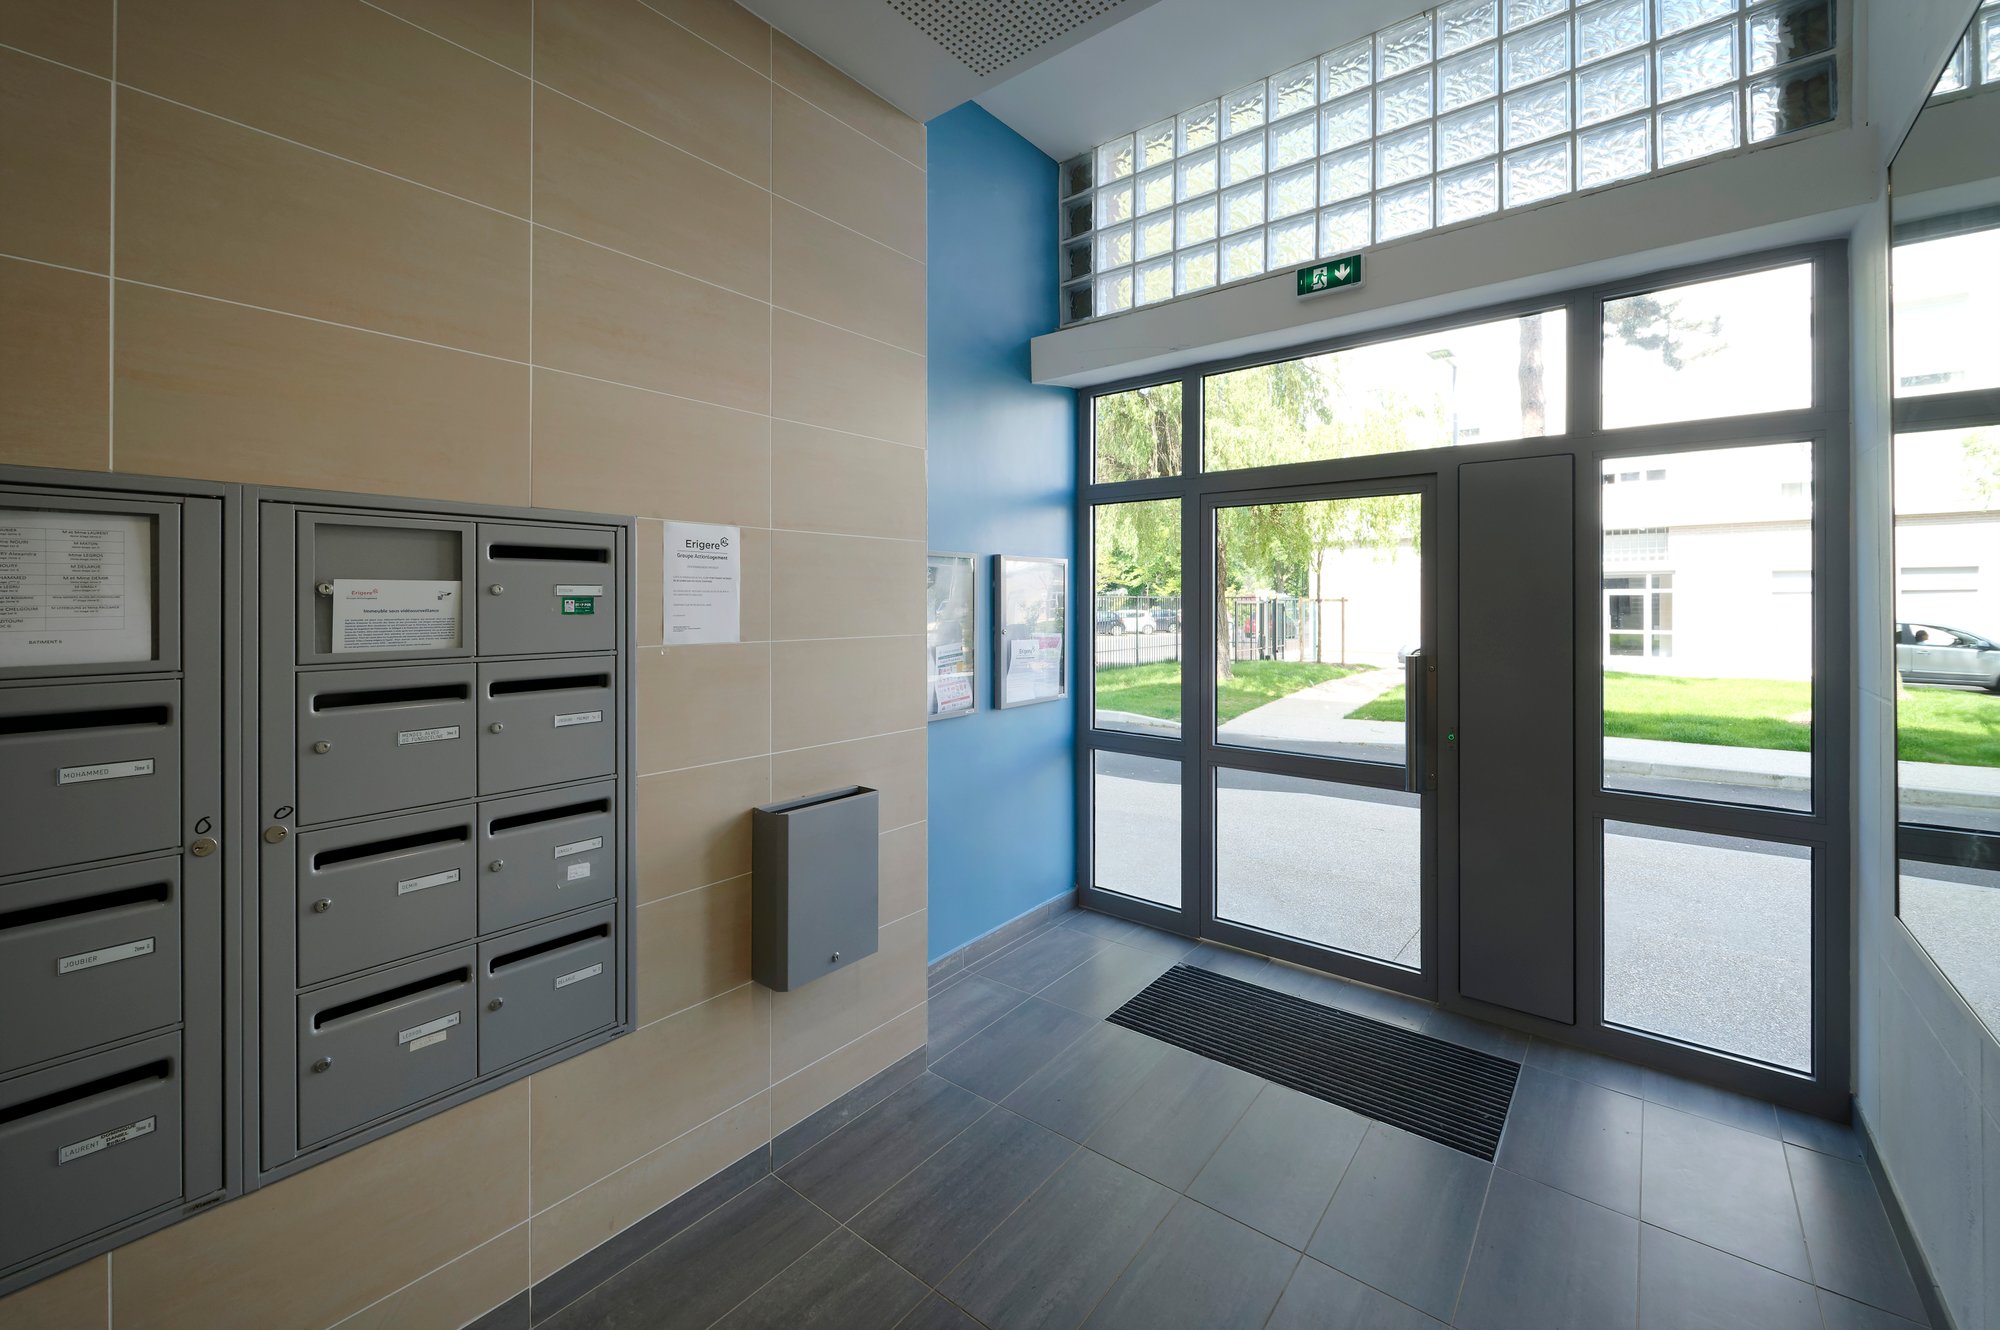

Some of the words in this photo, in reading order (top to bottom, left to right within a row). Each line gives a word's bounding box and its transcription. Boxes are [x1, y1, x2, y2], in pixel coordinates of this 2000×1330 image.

[685, 539, 721, 551] Erigere
[63, 768, 109, 779] MOHAMMED
[63, 955, 98, 969] JOUBIER
[64, 1140, 100, 1157] LAURENT
